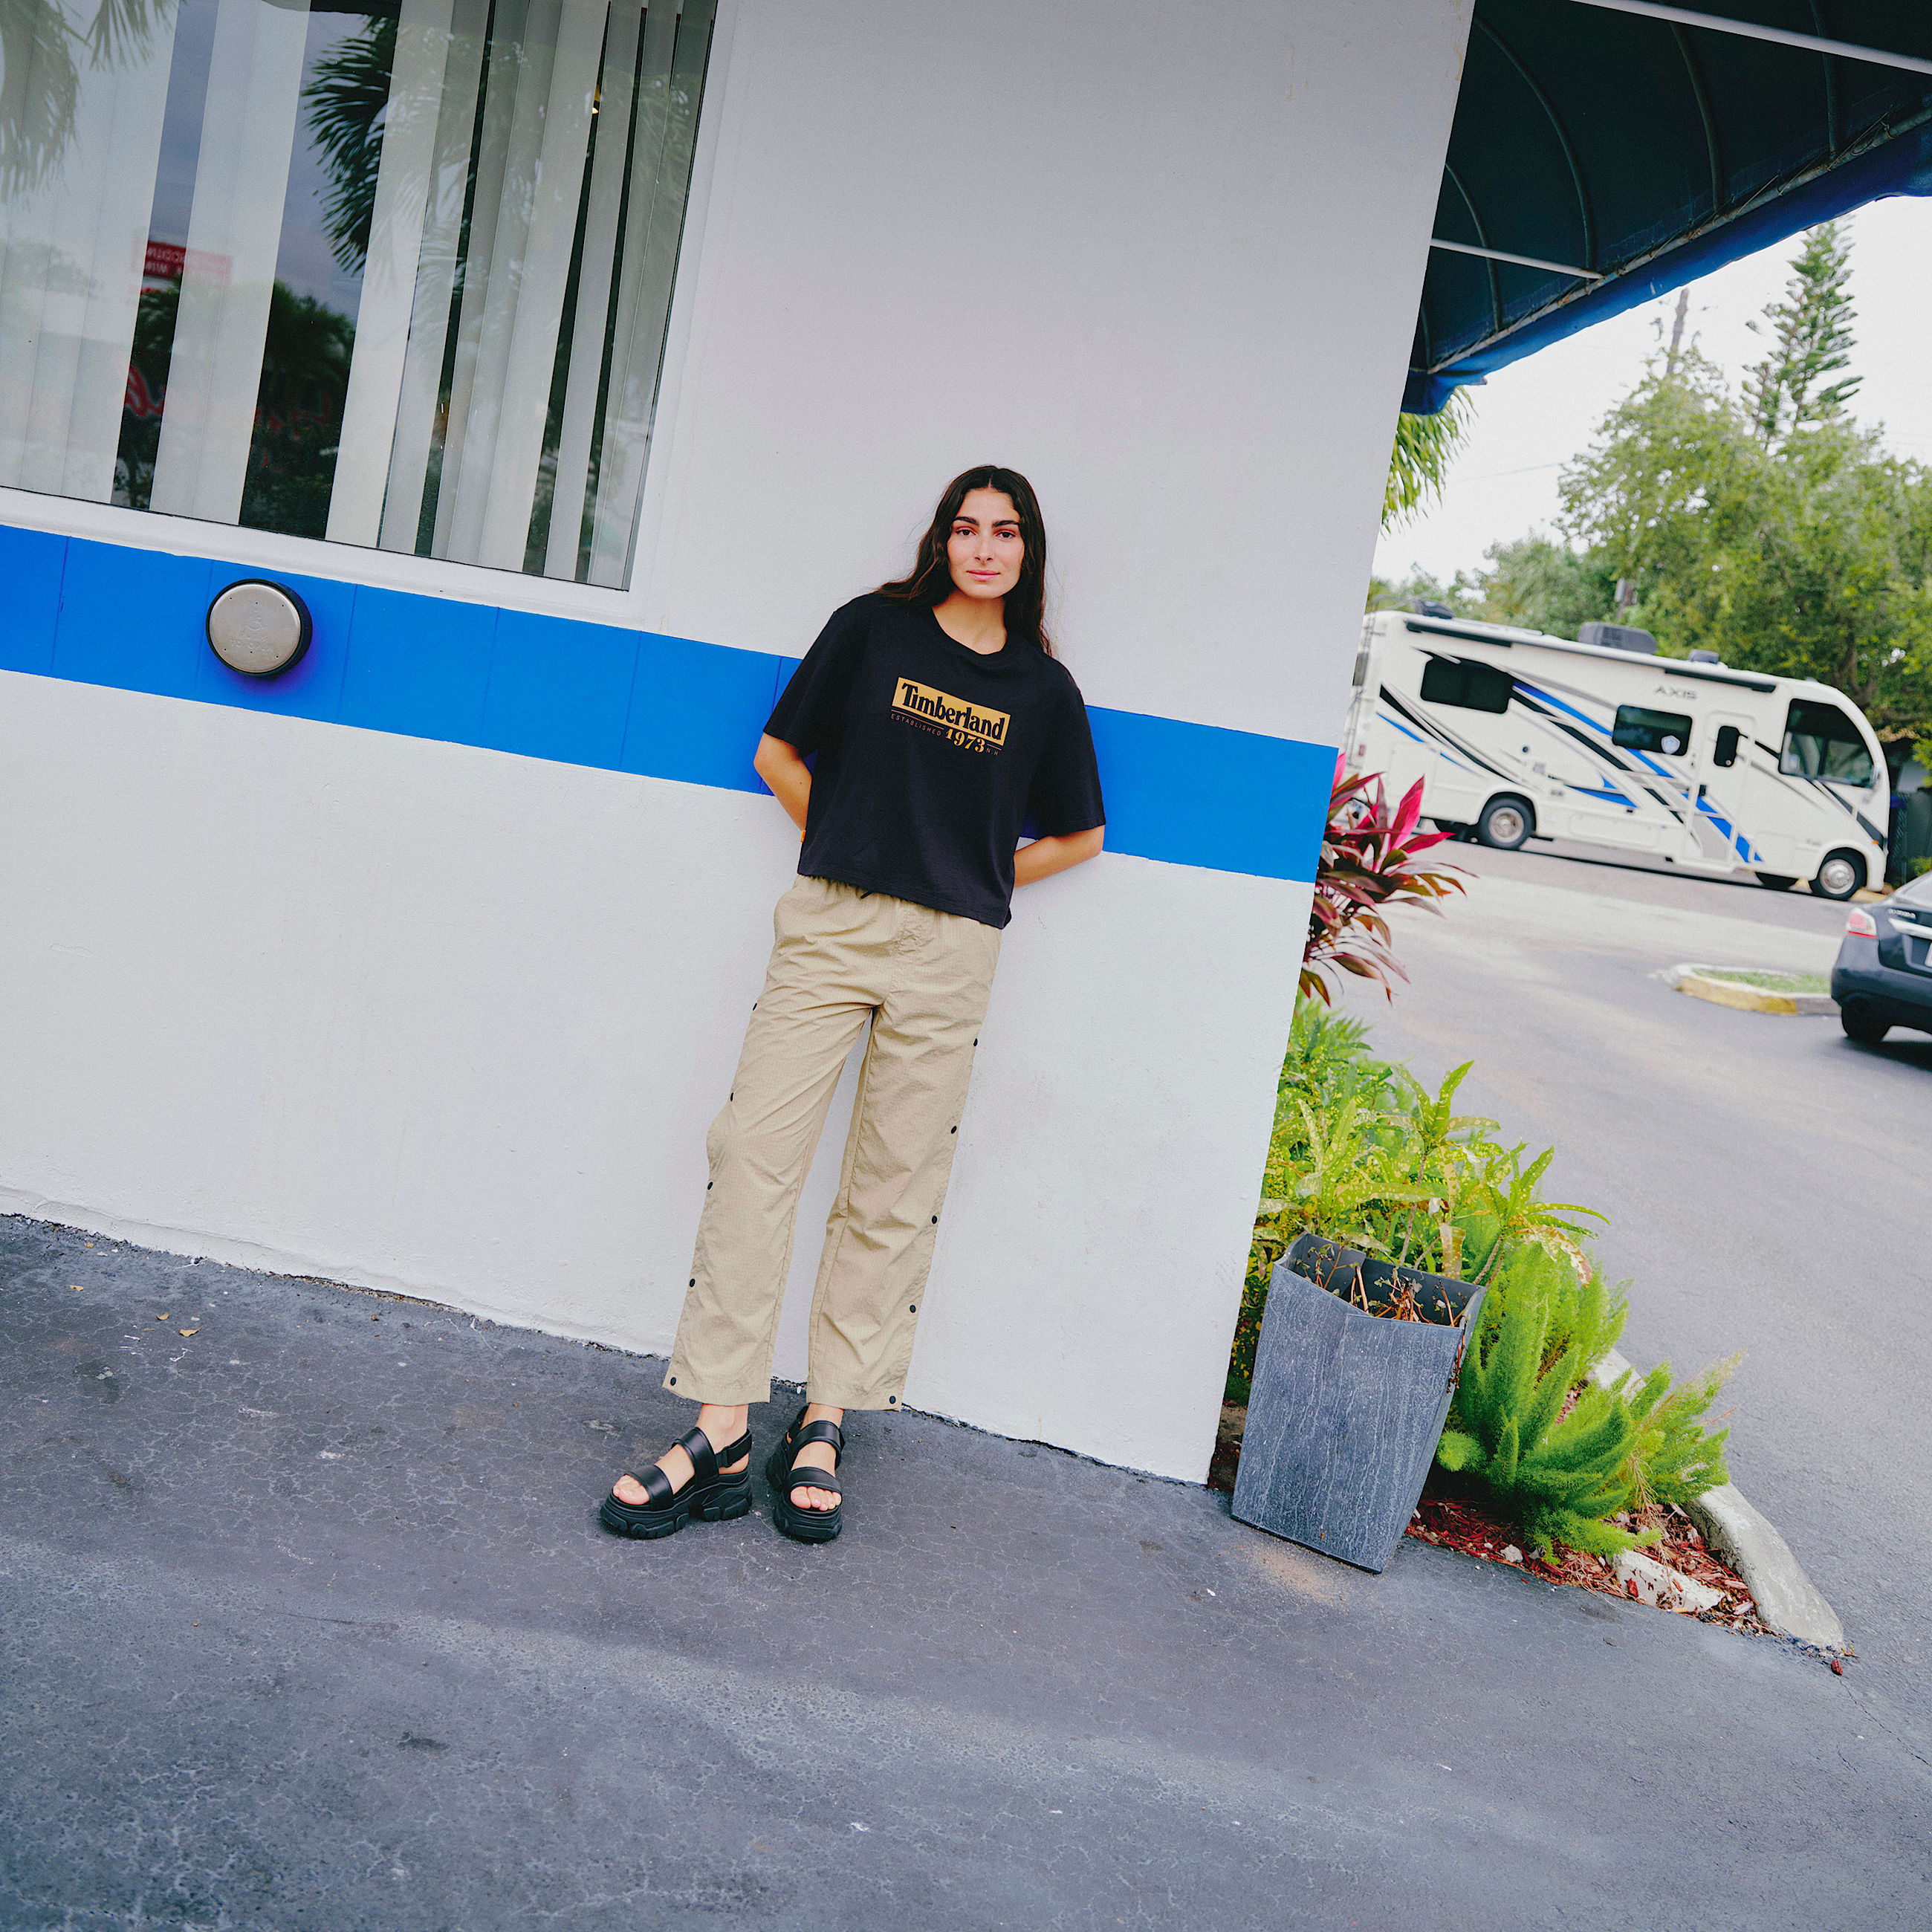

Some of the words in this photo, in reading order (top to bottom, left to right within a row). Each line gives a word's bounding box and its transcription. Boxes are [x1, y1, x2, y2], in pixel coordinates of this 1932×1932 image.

[901, 682, 1005, 740] Timberland
[1654, 686, 1697, 699] AXIS
[891, 713, 941, 736] ESTABLISHED
[945, 728, 985, 753] 1973
